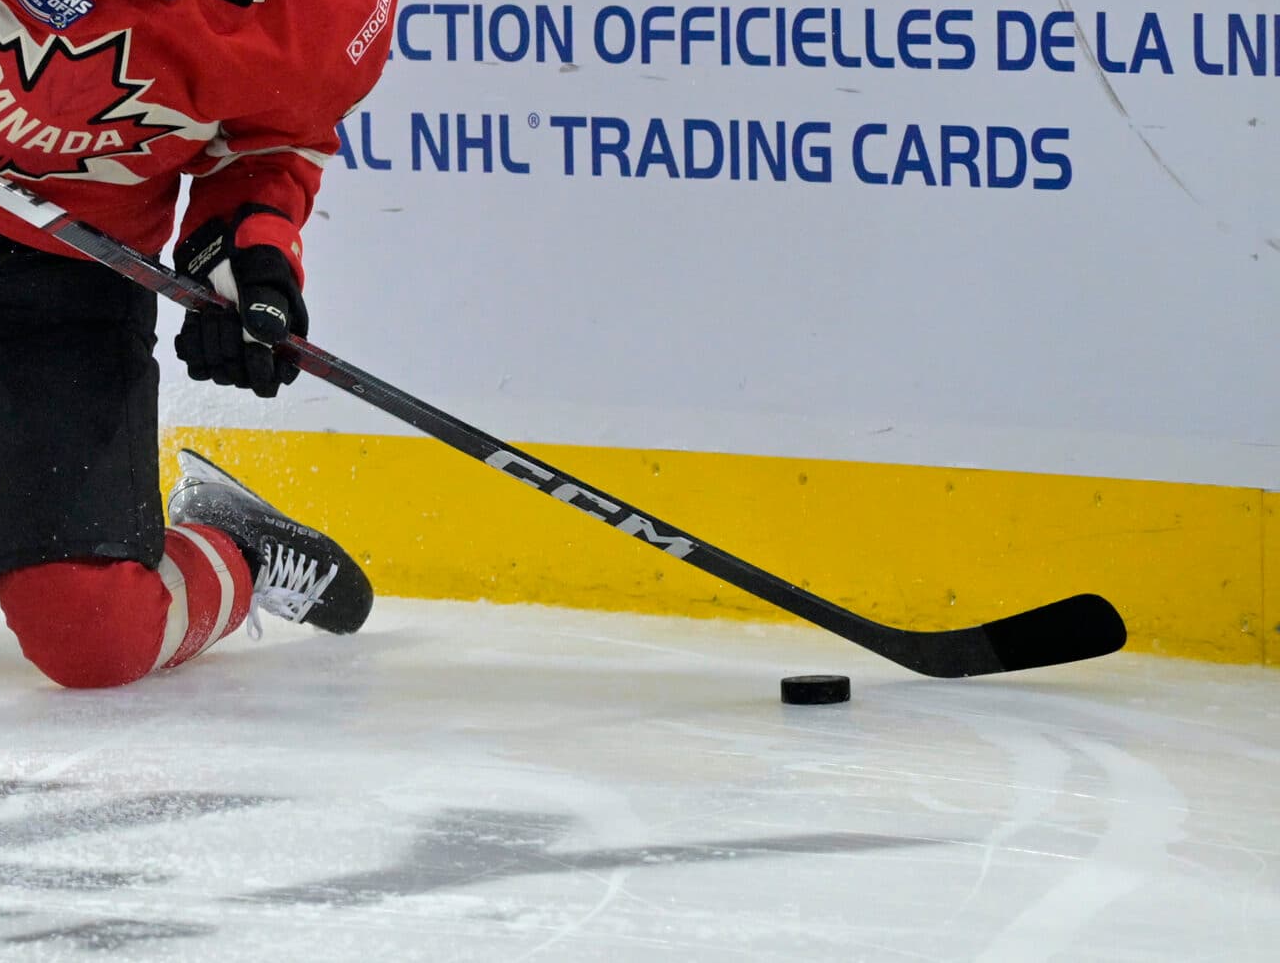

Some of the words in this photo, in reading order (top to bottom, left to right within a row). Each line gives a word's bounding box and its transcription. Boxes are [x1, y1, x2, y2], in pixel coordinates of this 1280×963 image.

[387, 3, 573, 63] CTION
[593, 4, 976, 71] OFFICIELLES
[997, 9, 1075, 73] DE
[1096, 11, 1175, 75] LA
[550, 115, 832, 183] TRADING
[852, 122, 1073, 191] CARDS
[484, 448, 700, 559] CCM
